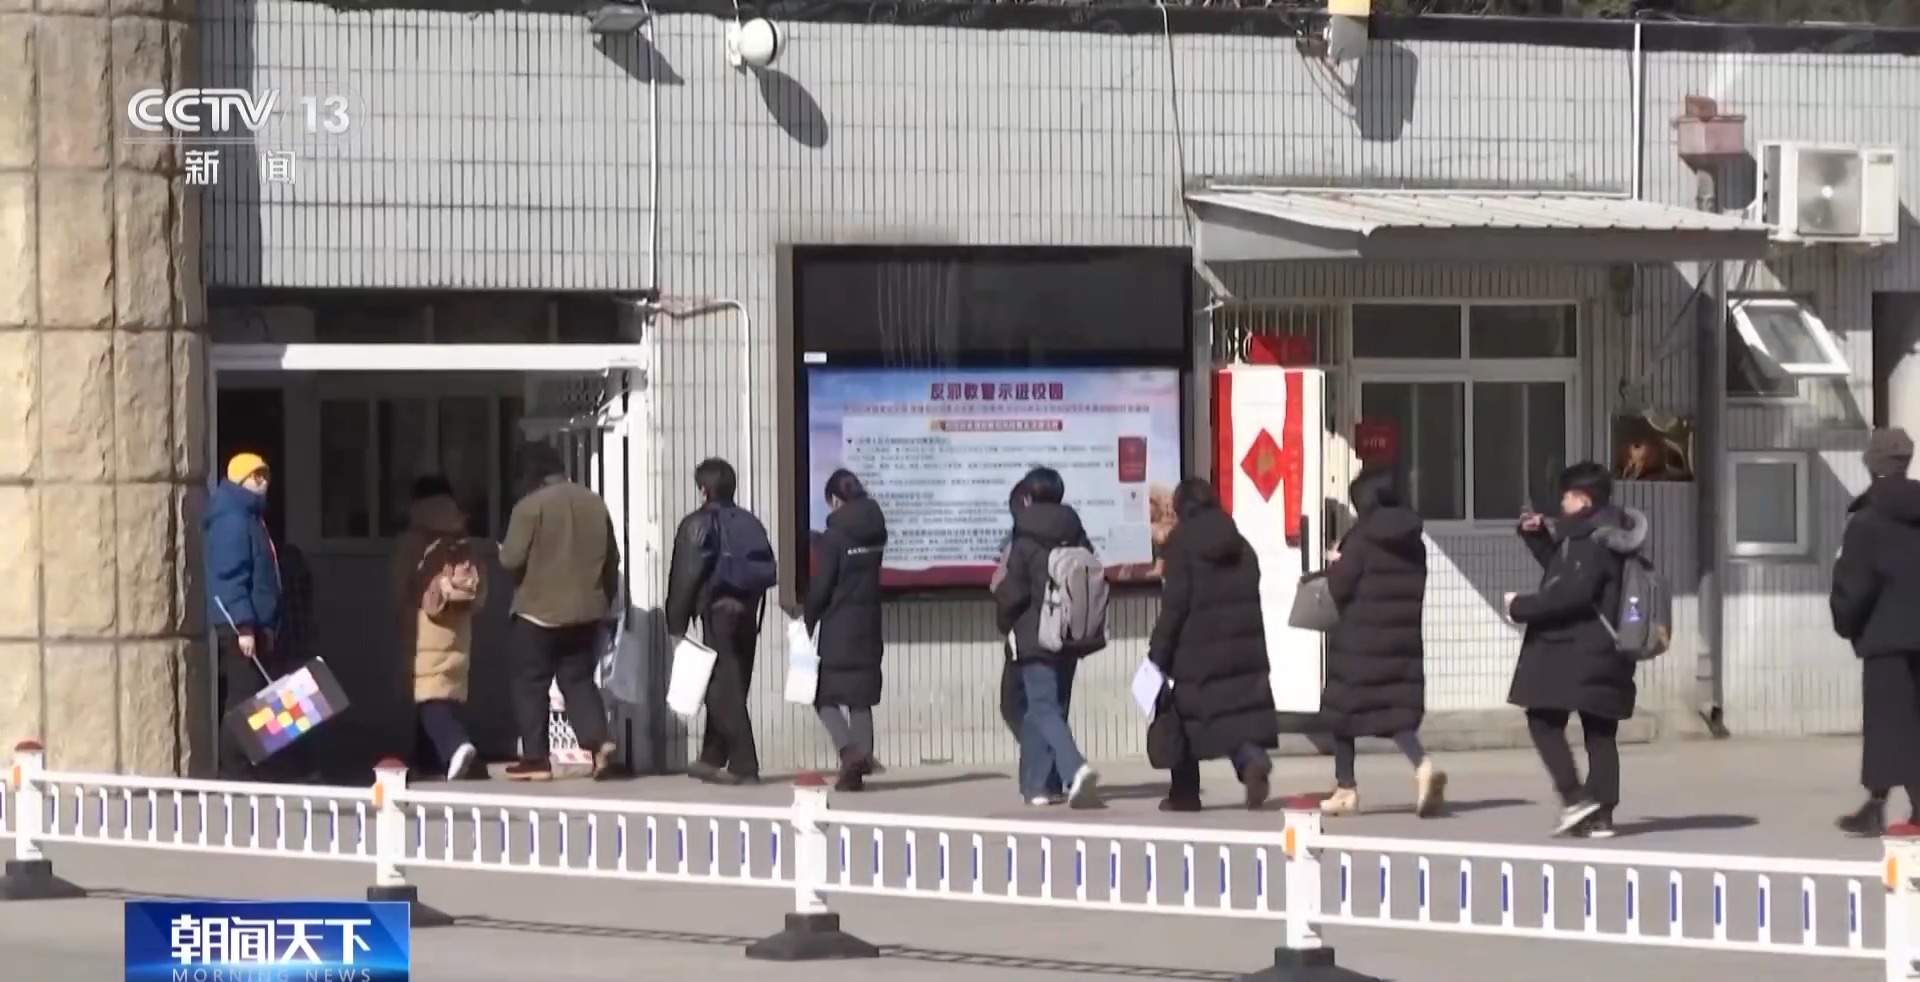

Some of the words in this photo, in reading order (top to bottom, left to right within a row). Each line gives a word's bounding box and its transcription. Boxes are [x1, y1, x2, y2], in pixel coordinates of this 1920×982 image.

[931, 383, 1063, 400] 反邪教警示进校园
